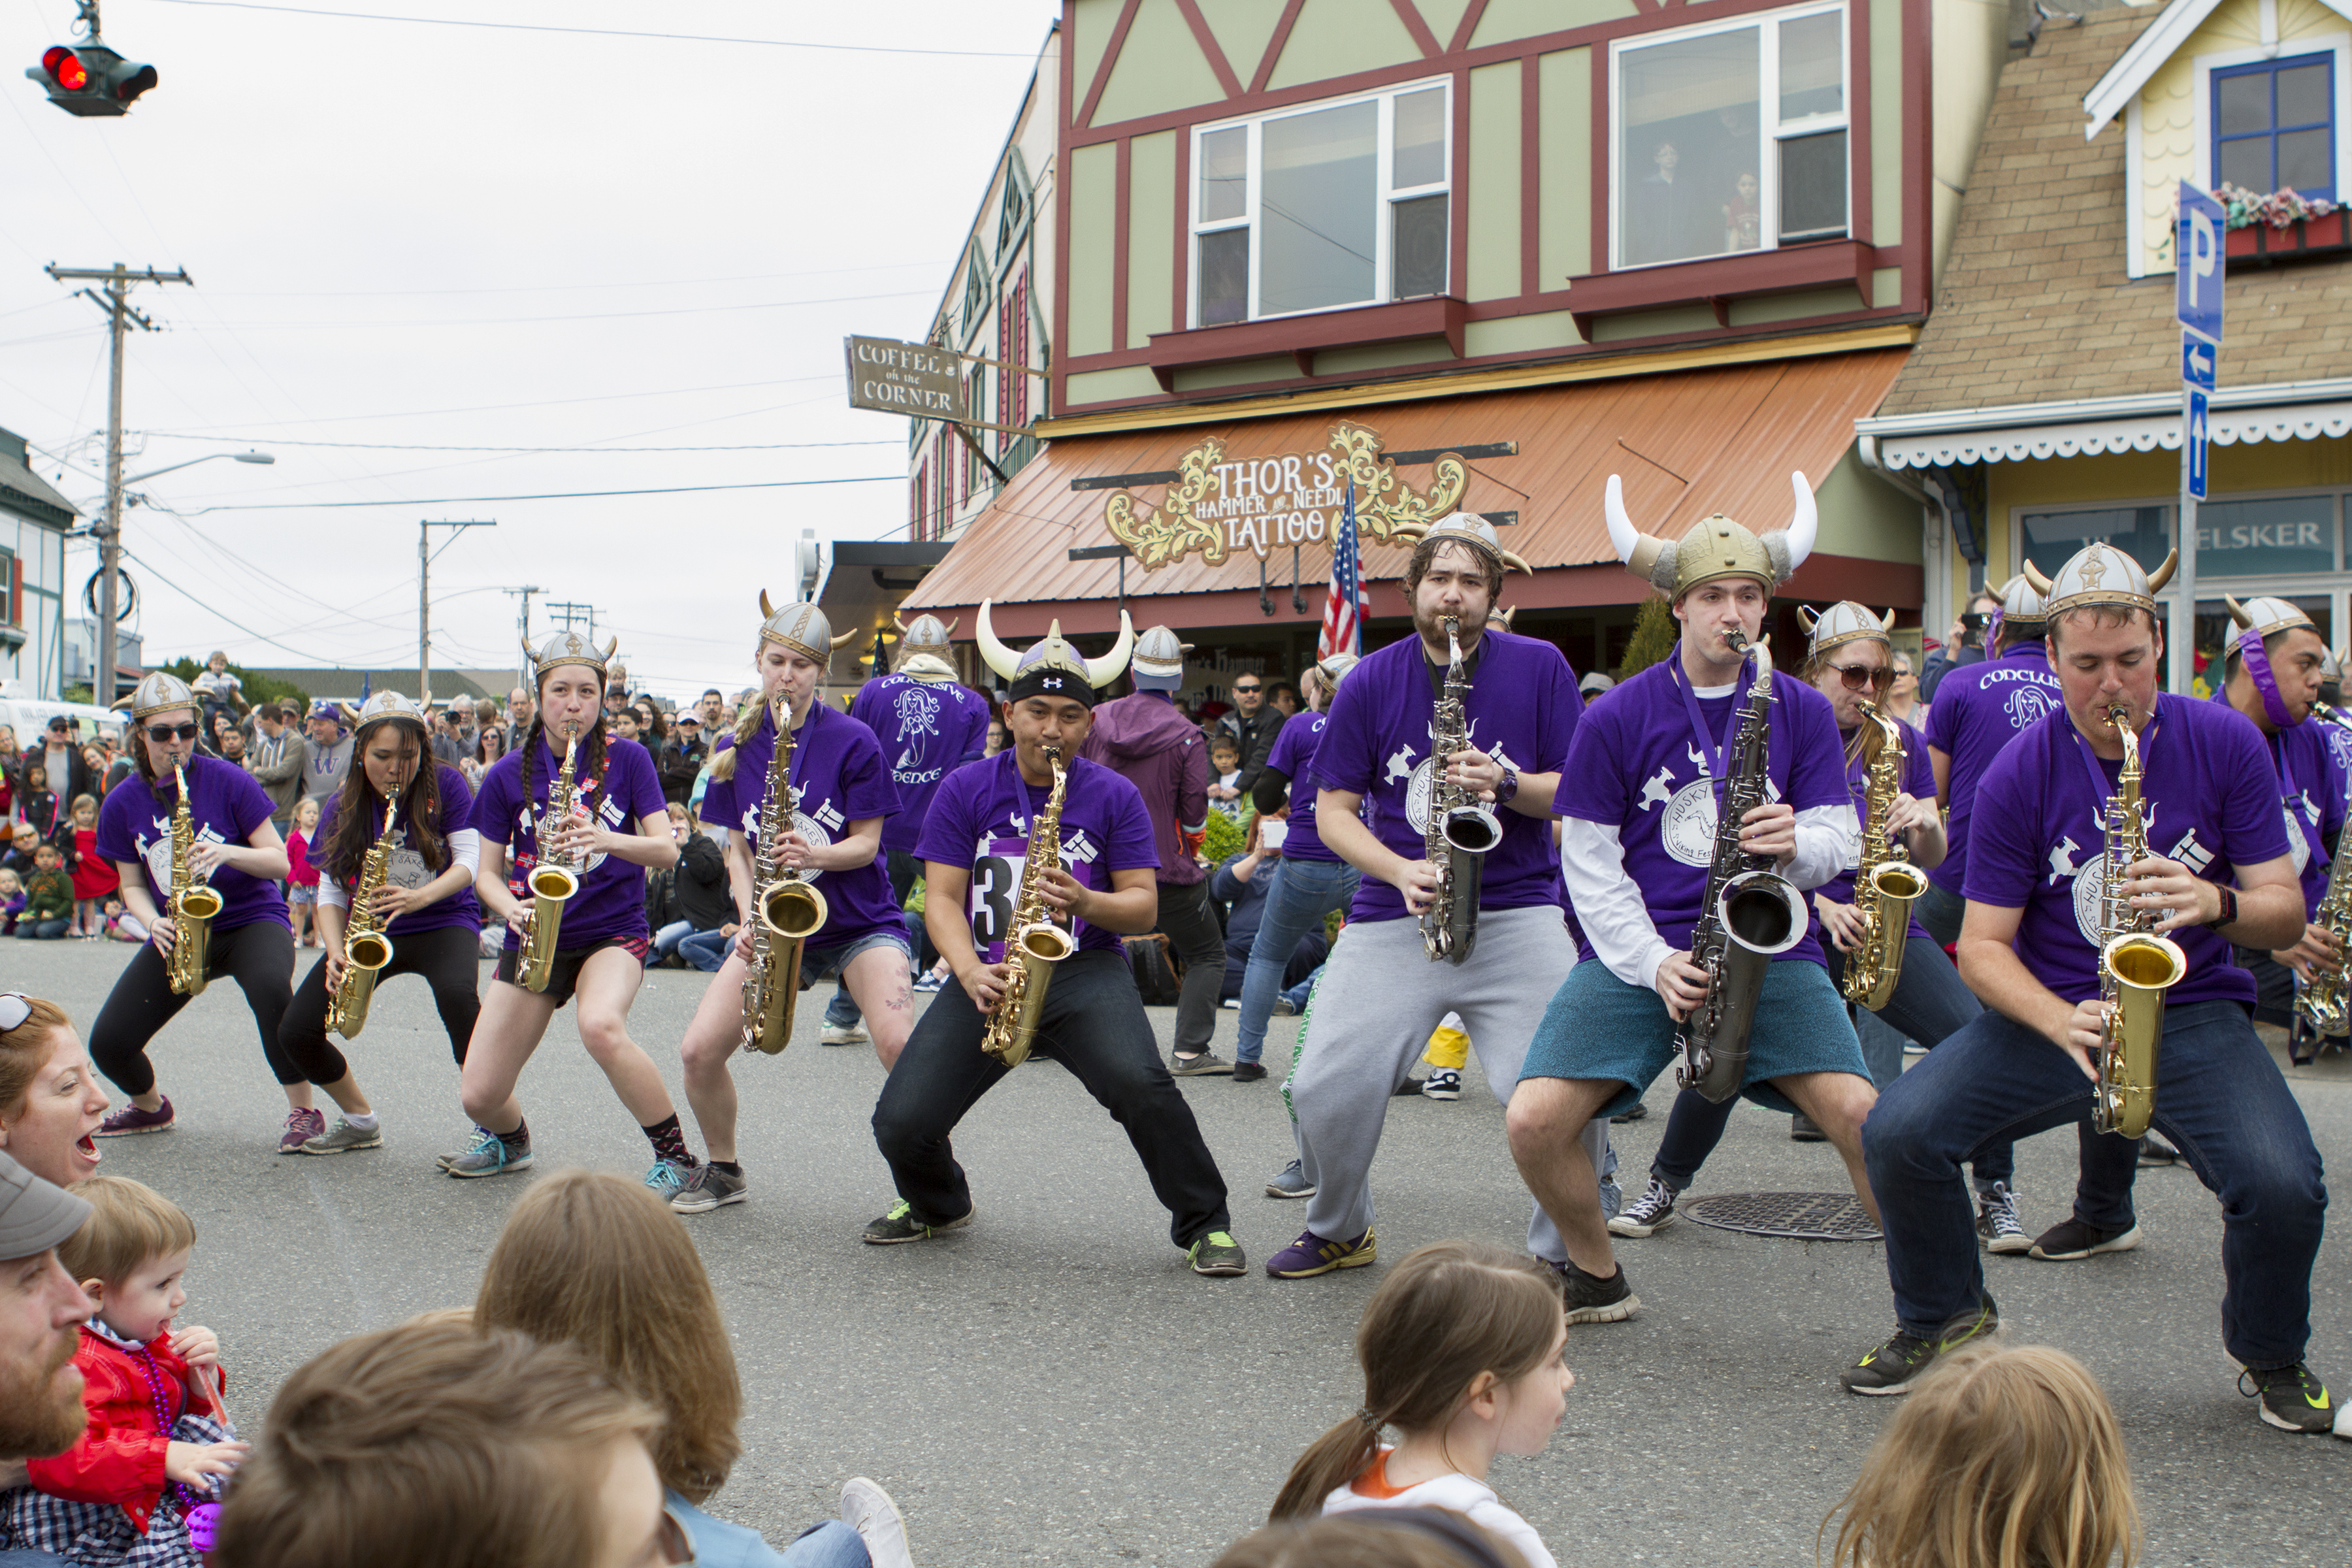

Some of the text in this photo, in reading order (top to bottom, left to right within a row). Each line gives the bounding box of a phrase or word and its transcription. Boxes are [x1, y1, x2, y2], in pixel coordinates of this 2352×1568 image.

[2189, 207, 2216, 308] P
[858, 344, 940, 374] COFFEE
[904, 370, 920, 384] the
[864, 380, 952, 411] CORNER
[1212, 453, 1335, 499] THOR'S
[1195, 487, 1346, 519] HAMMER AND NEEDL
[1223, 510, 1325, 557] TATTOO
[2196, 523, 2321, 550] ELSKER
[1980, 669, 2063, 689] CONCLUS
[312, 758, 340, 775] W
[891, 767, 941, 784] DENCE
[1673, 786, 1708, 823] HUSKY
[793, 819, 819, 846] SAXES
[2287, 819, 2303, 844] AXES
[1676, 840, 1712, 858] Viking Fes
[399, 855, 425, 872] SAXES
[2083, 868, 2104, 904] HUS
